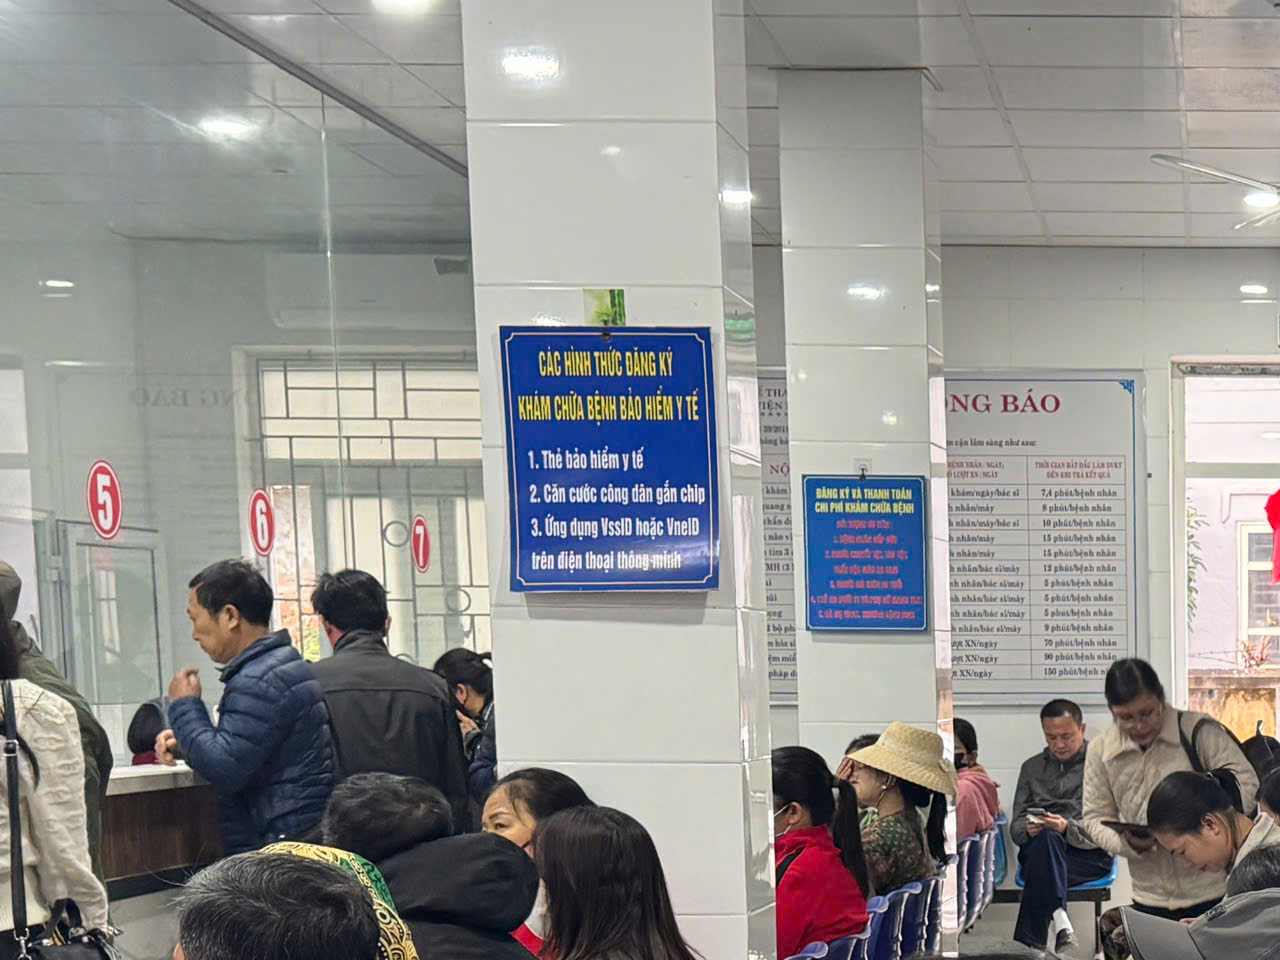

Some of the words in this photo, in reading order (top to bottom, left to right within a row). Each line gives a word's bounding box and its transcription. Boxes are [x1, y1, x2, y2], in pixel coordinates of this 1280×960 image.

[538, 346, 562, 377] CÁC
[564, 346, 591, 377] HÌNH
[594, 346, 622, 377] THỨC
[625, 347, 656, 377] ĐĂNG
[659, 346, 673, 377] KÝ
[518, 390, 551, 421] KHÁM
[554, 390, 585, 421] CHỮA
[587, 390, 617, 426] BỆNH
[620, 387, 642, 420] BẢO
[645, 385, 674, 420] HIỂM
[676, 395, 683, 420] Y
[686, 388, 700, 420] TẾ
[945, 393, 992, 413] NG
[1000, 388, 1061, 413] BÁO
[528, 450, 539, 469] 1.
[541, 447, 563, 469] Thẻ
[565, 447, 587, 469] bảo
[590, 445, 619, 469] hiểm
[622, 453, 630, 471] y
[632, 446, 644, 469] tế
[95, 473, 113, 529] 5
[529, 484, 541, 503] 2.
[543, 483, 566, 503] Căn
[569, 483, 597, 503] cước
[600, 483, 628, 505] công
[631, 483, 653, 503] dân
[656, 480, 677, 505] gắn
[680, 483, 706, 505] chip
[254, 499, 269, 547] 6
[531, 517, 542, 537] 3.
[545, 513, 567, 538] Ứng
[570, 517, 598, 540] dụng
[601, 517, 632, 537] VssID
[635, 517, 664, 540] hoặc
[667, 517, 700, 536] VneID
[415, 525, 425, 566] 7
[531, 551, 554, 570] trên
[557, 551, 582, 573] điện
[585, 551, 614, 573] thoại
[617, 550, 649, 571] thông
[652, 551, 682, 569] minh
